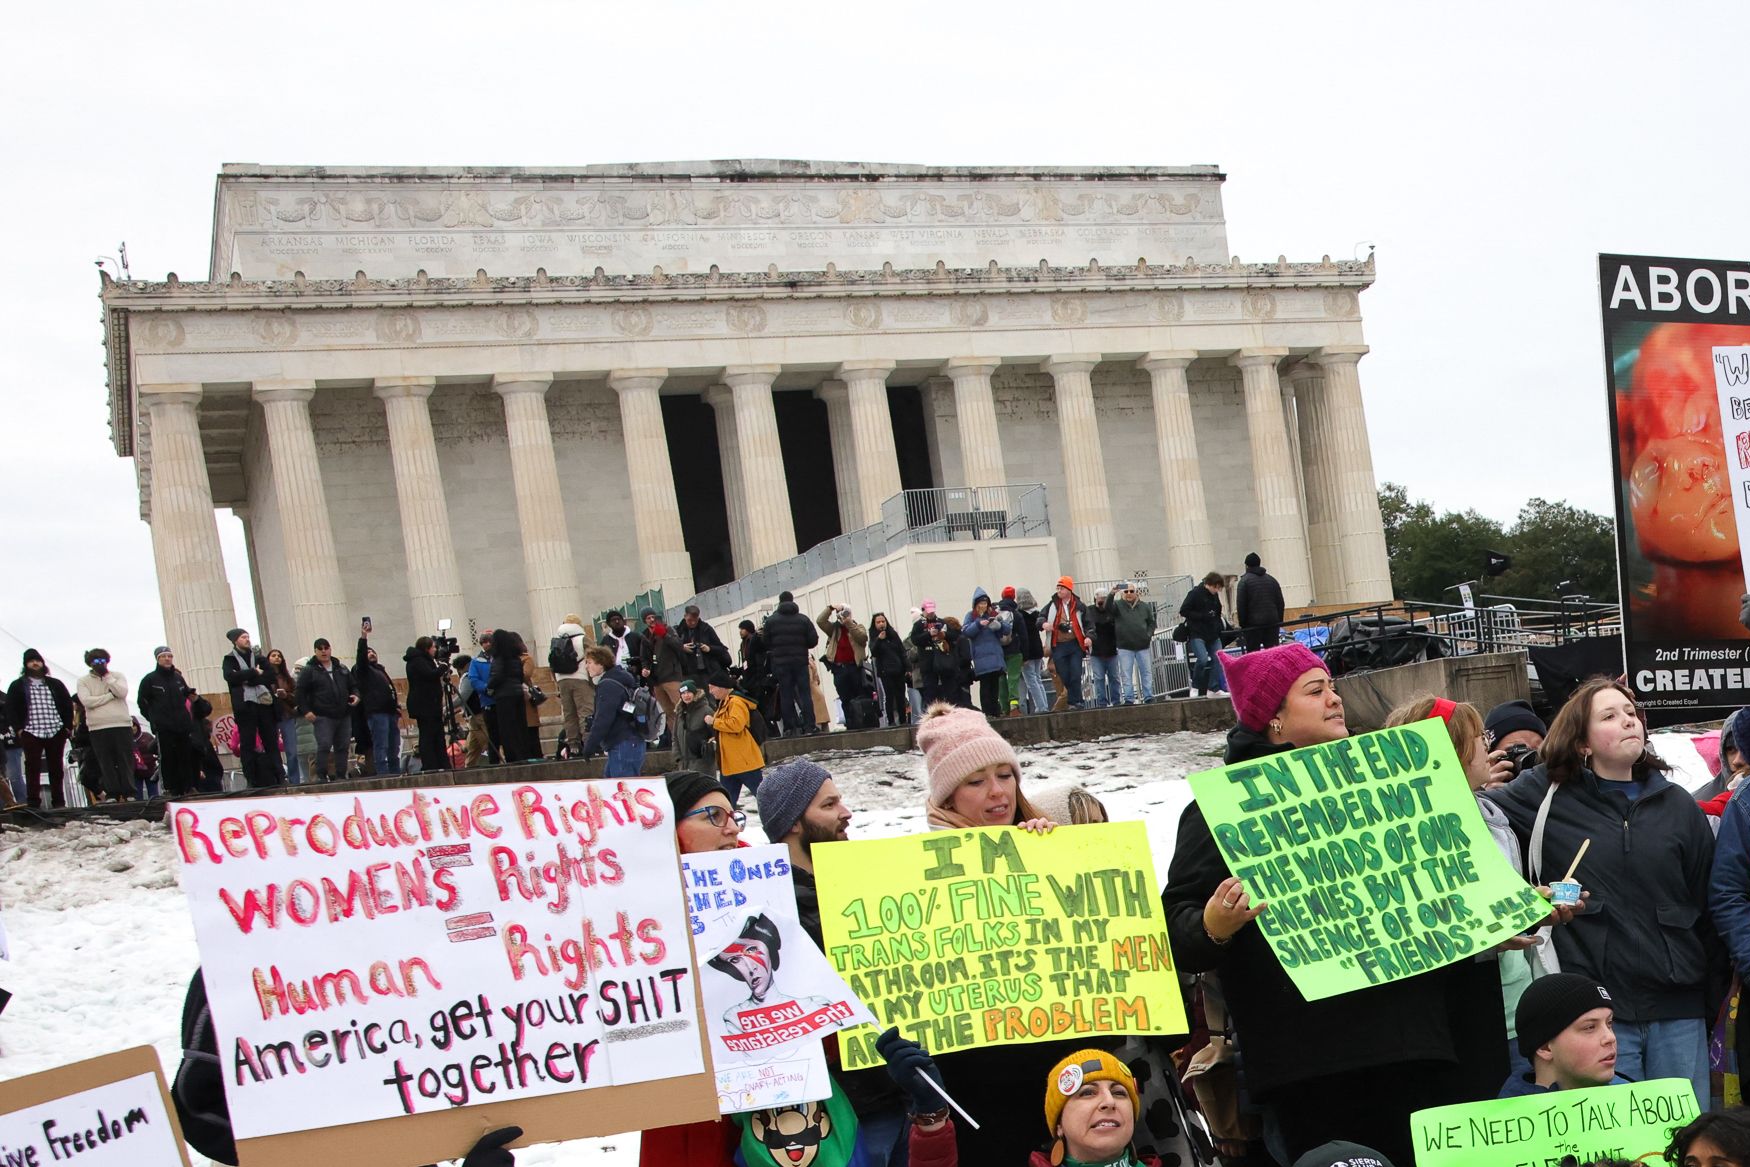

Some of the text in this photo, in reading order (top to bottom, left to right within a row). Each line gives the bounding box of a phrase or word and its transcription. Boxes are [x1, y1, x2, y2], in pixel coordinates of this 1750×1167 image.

[260, 236, 324, 247] ARKANSAS
[335, 236, 396, 247] MICHIGAN
[407, 235, 457, 246] FLORIDA
[566, 233, 632, 244] WISCONSIN
[512, 780, 666, 846] Rights
[1212, 775, 1434, 862] REMEMBER NOT
[490, 841, 627, 915] Rights
[922, 829, 1026, 880] I'M
[1236, 812, 1471, 899] THE WORDS OF OUR
[841, 867, 1154, 940] 100% FINE WITH
[251, 911, 668, 1021] Human Rights
[830, 917, 1109, 972] TRANS FOLKS IN MY
[979, 931, 1174, 978] IT'S THE MEN
[885, 969, 1131, 1023] MY UTERUS THAT
[234, 968, 689, 1087] America, get your SHIT
[383, 1038, 602, 1114] together
[41, 1105, 150, 1162] Freedom
[1422, 1090, 1696, 1153] WE NEED TO TALK ABOUT
[1348, 1156, 1383, 1167] SIERRA
